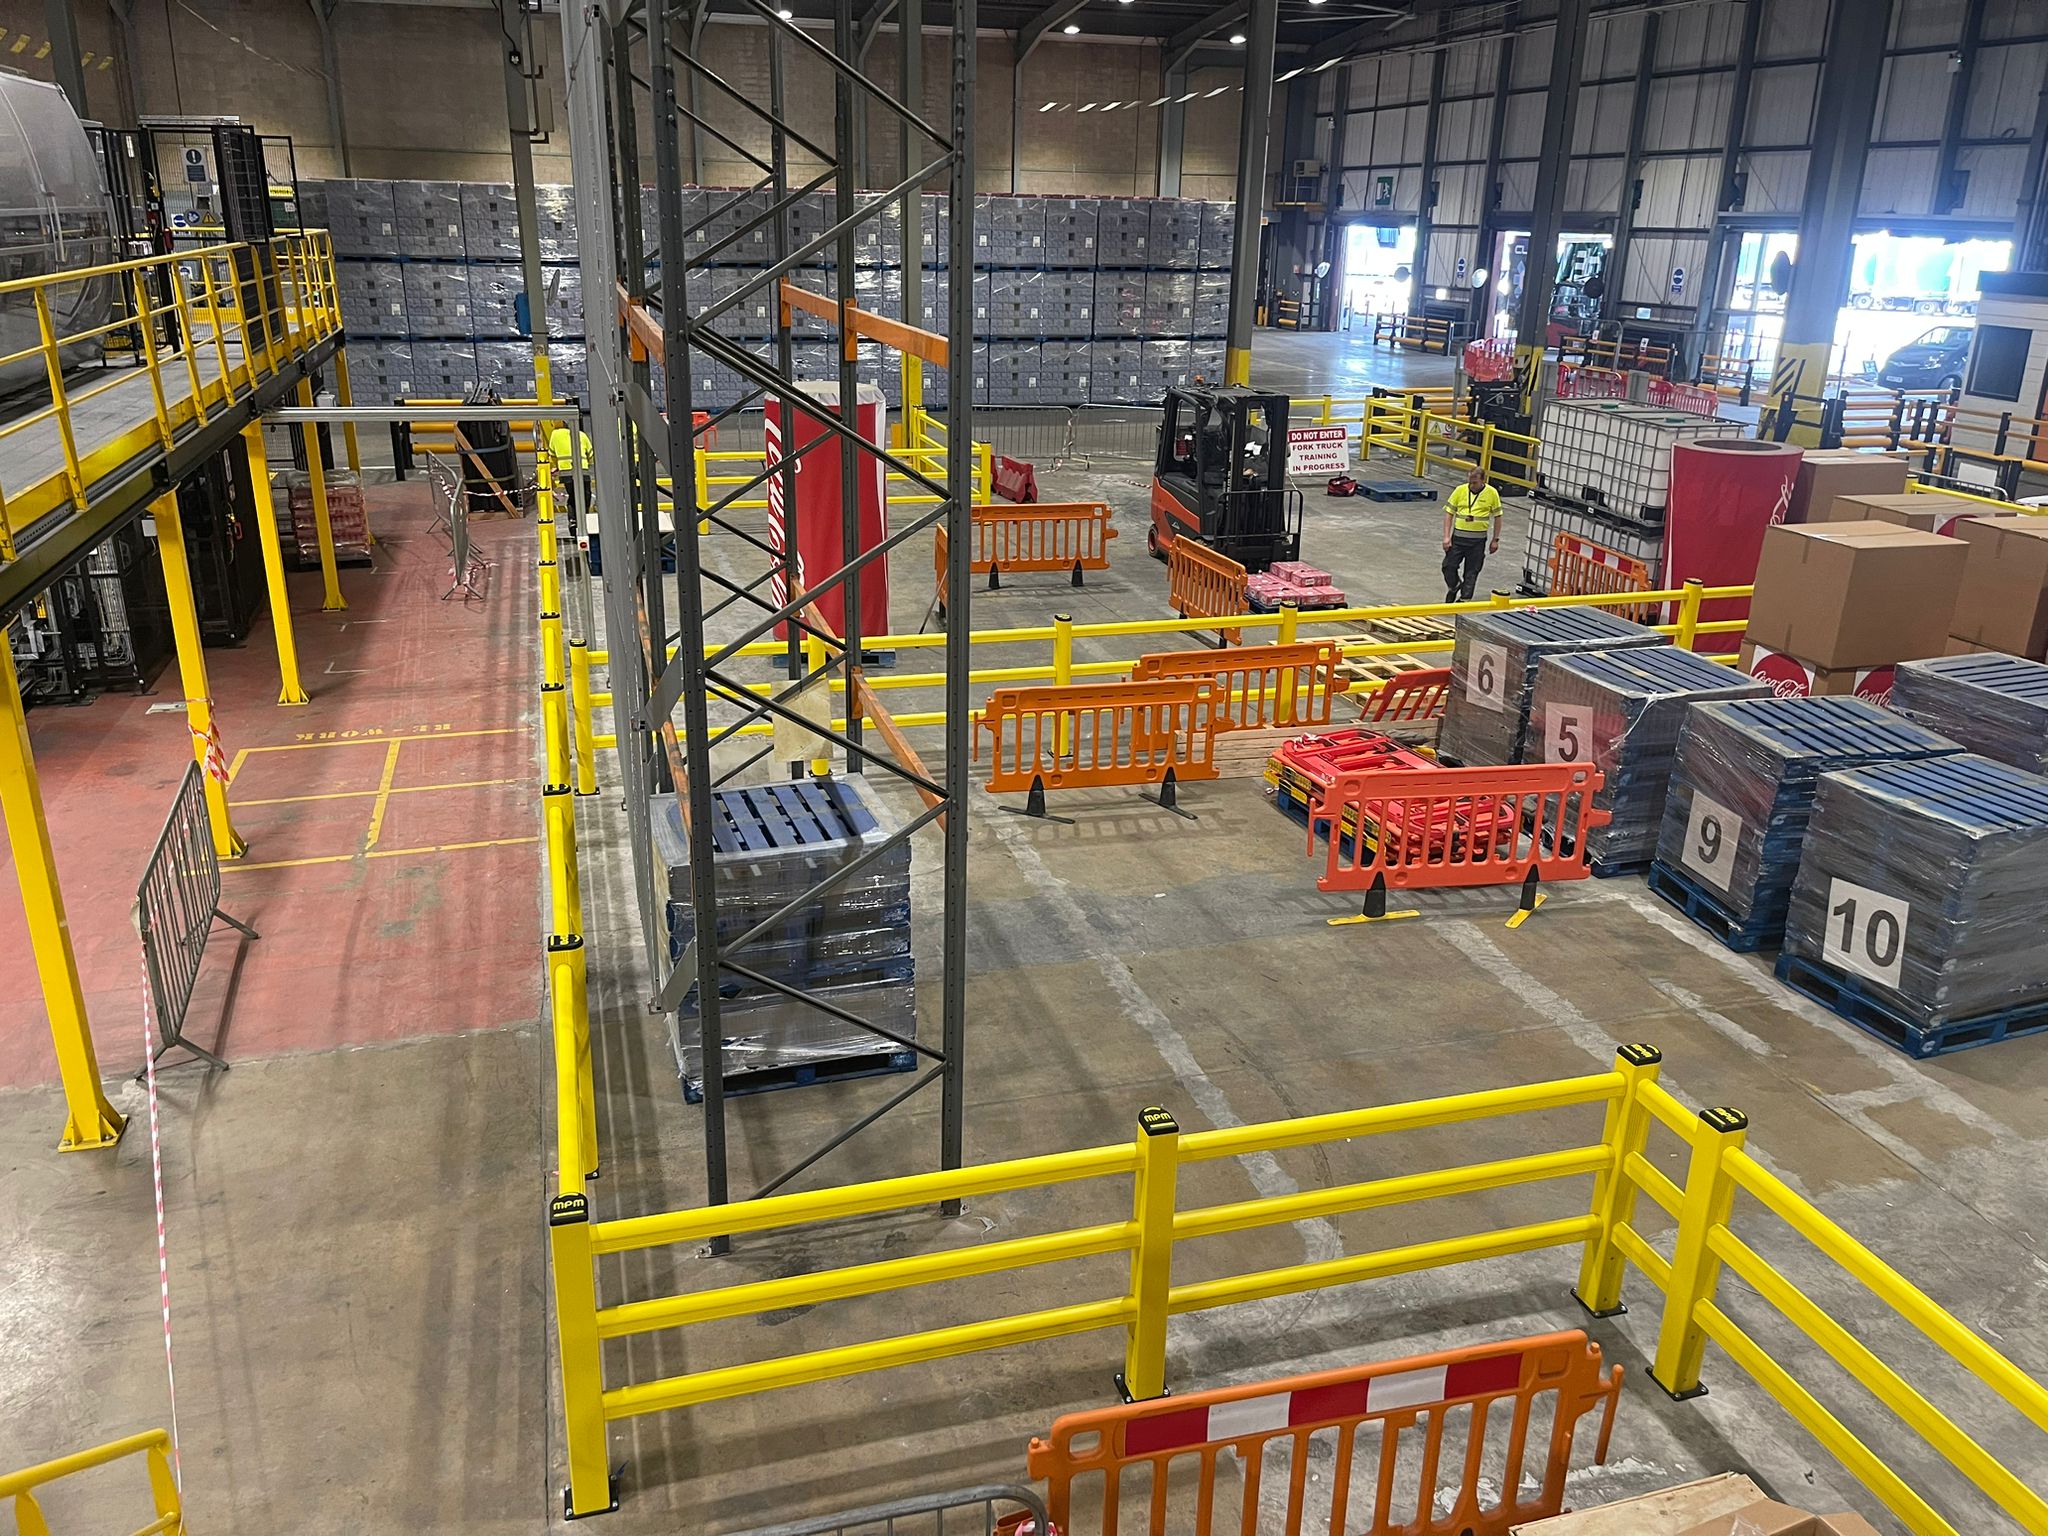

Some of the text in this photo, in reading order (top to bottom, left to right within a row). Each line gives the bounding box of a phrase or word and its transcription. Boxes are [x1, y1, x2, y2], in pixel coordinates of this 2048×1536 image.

[1477, 654, 1495, 696] 6
[1558, 716, 1579, 763] 5
[1697, 814, 1723, 865] 9
[1832, 898, 1901, 968] 10
[1143, 1112, 1172, 1122] mpm
[553, 1198, 585, 1211] mpm
